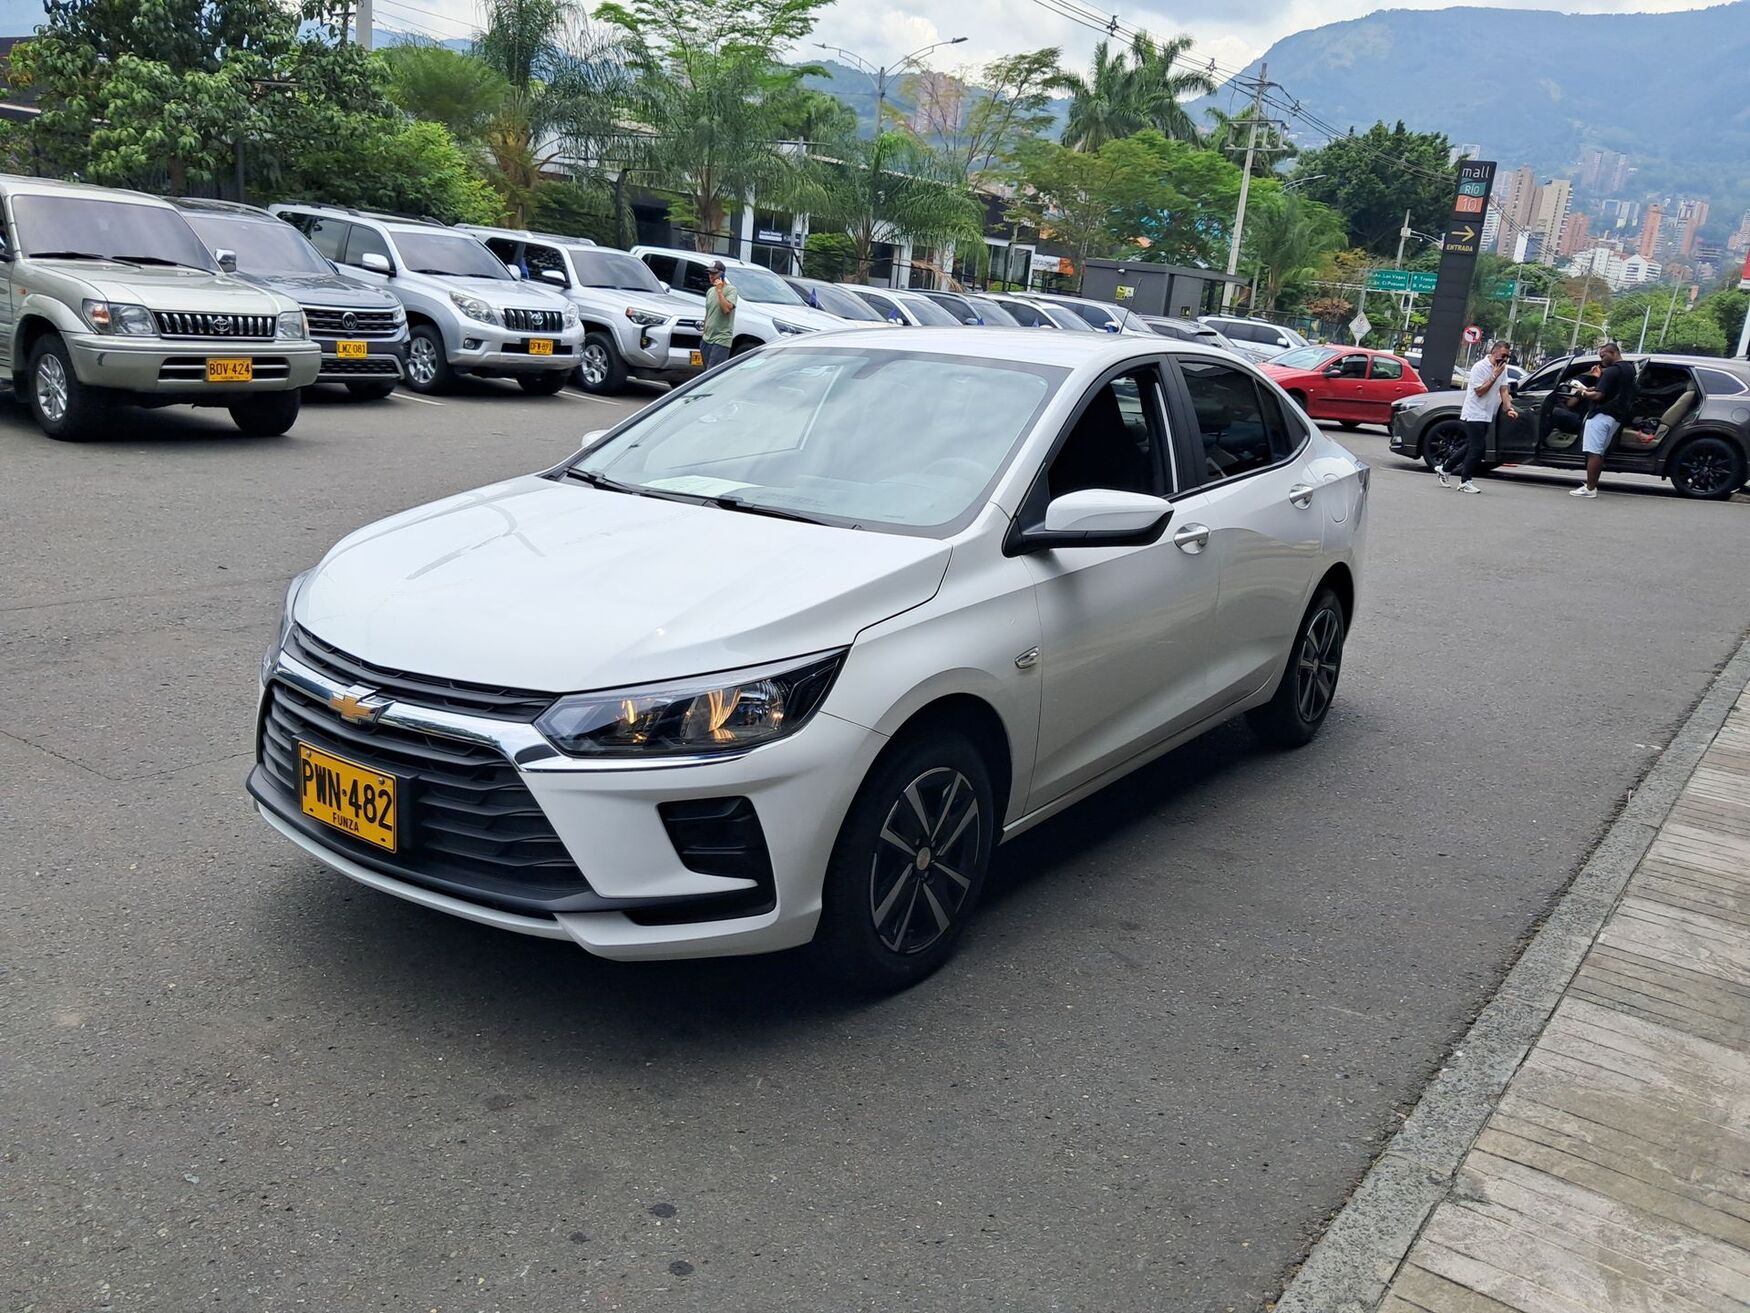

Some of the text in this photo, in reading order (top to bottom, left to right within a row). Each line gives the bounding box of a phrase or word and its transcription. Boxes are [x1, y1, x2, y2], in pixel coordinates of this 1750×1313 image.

[1461, 166, 1490, 178] mall
[1463, 198, 1477, 211] 10
[1446, 243, 1473, 252] ENTRADA
[332, 811, 360, 833] FUNZA
